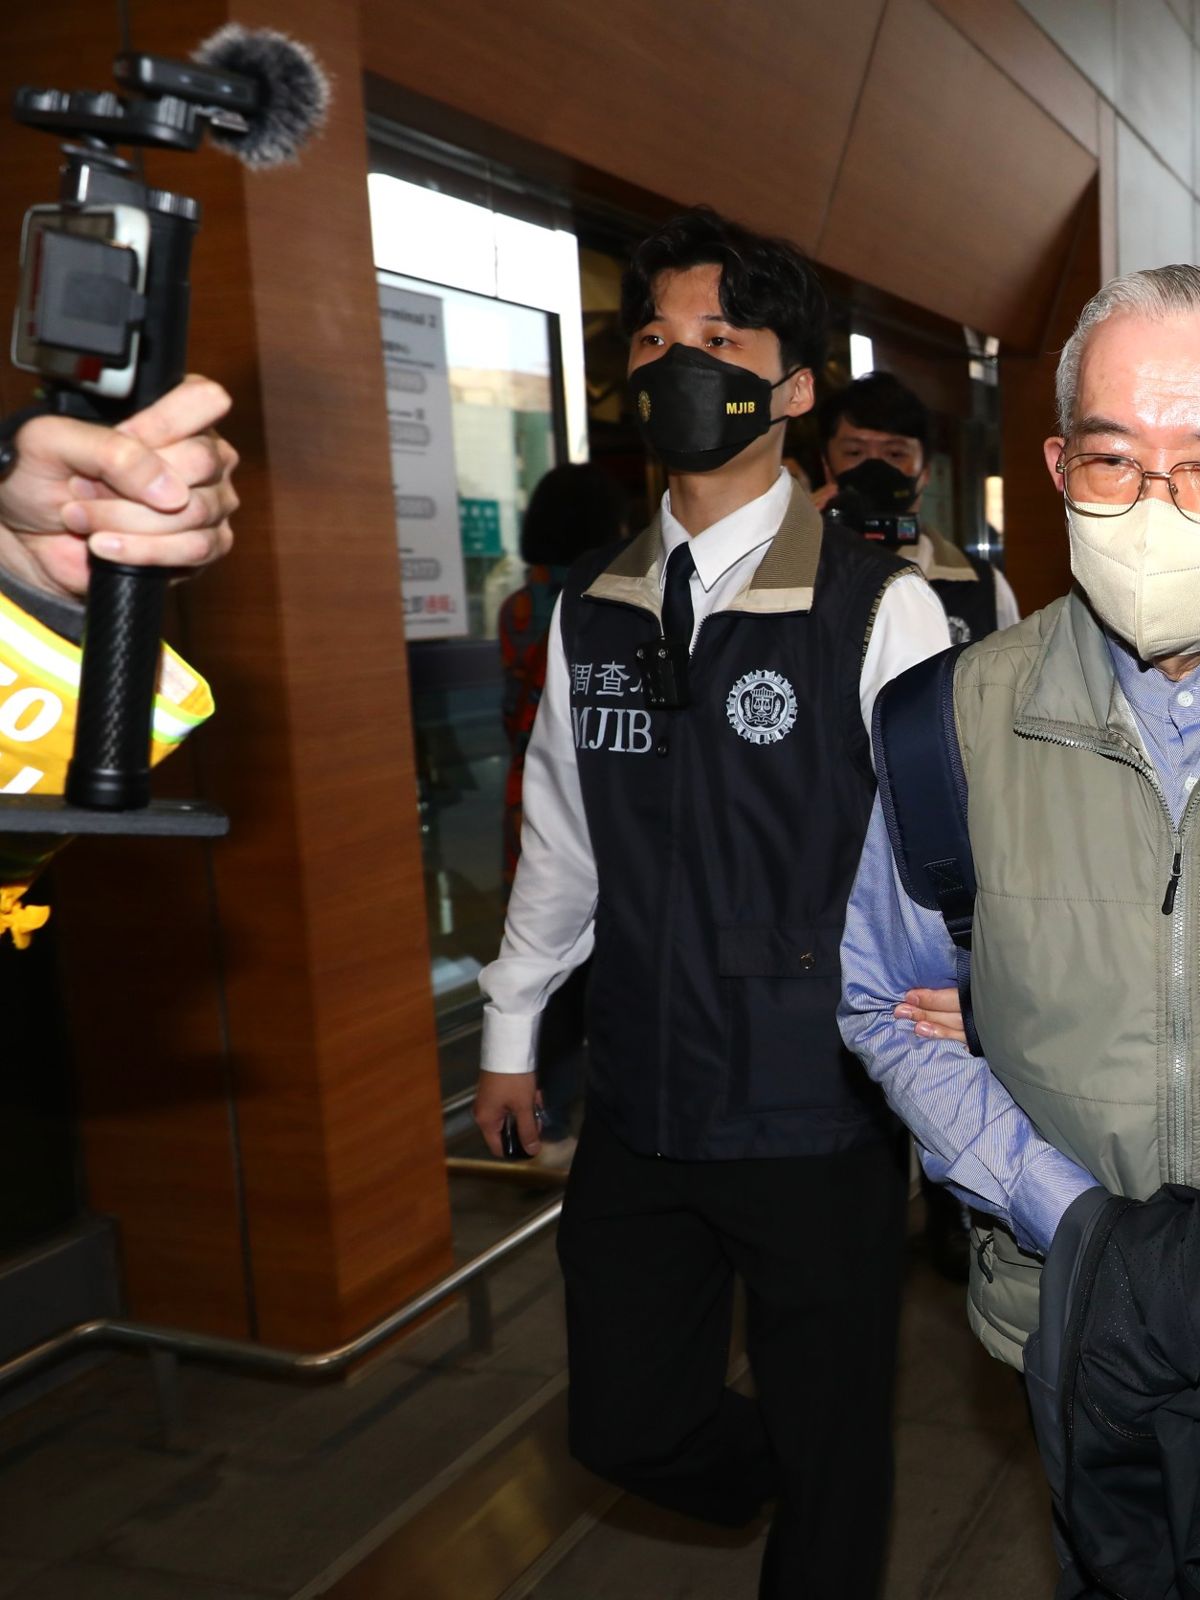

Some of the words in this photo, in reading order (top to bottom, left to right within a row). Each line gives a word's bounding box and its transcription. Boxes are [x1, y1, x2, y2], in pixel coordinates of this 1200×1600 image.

[726, 401, 755, 415] MJIB
[571, 660, 643, 697] 調查
[571, 706, 652, 753] MJIB
